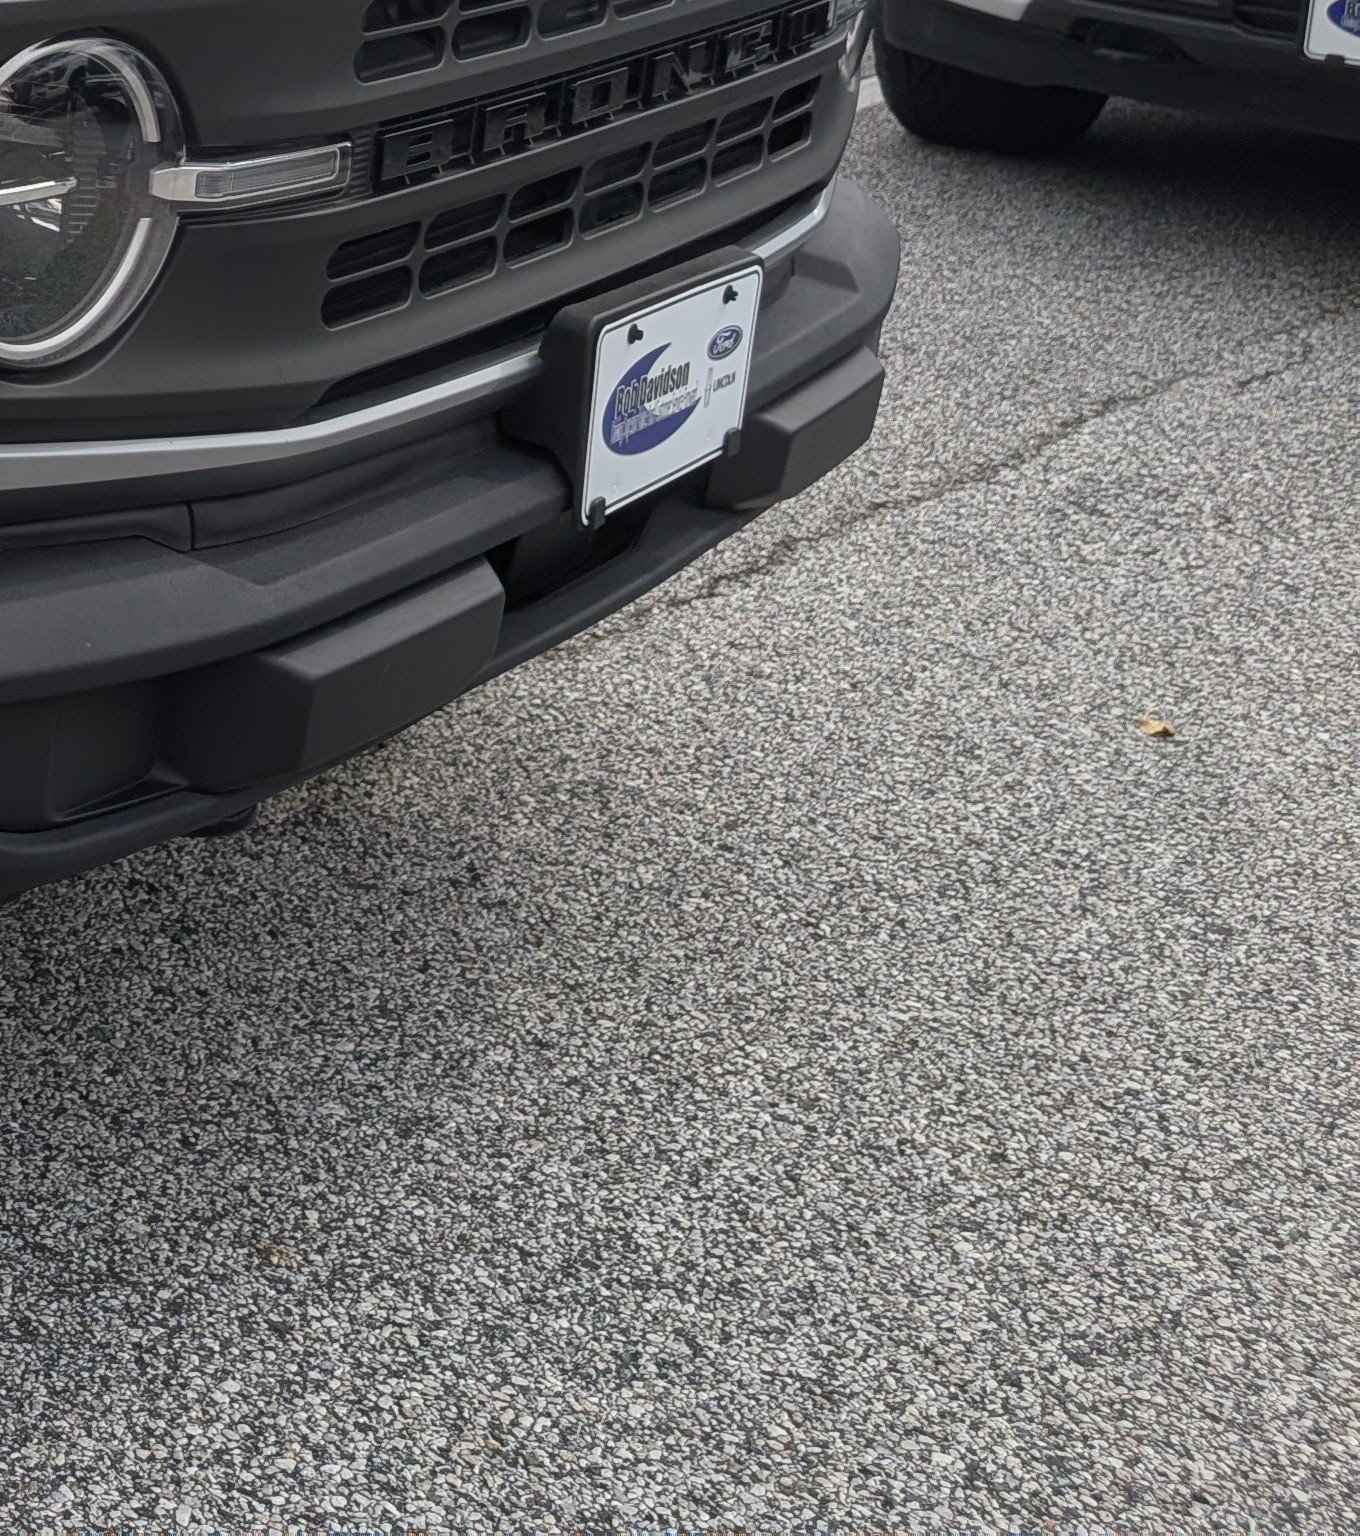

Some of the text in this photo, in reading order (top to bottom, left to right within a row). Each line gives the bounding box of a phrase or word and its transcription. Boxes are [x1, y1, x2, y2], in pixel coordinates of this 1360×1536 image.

[379, 0, 832, 182] BRONCO
[711, 329, 738, 356] Ford
[615, 380, 640, 421] Bob
[639, 360, 691, 407] Davidson
